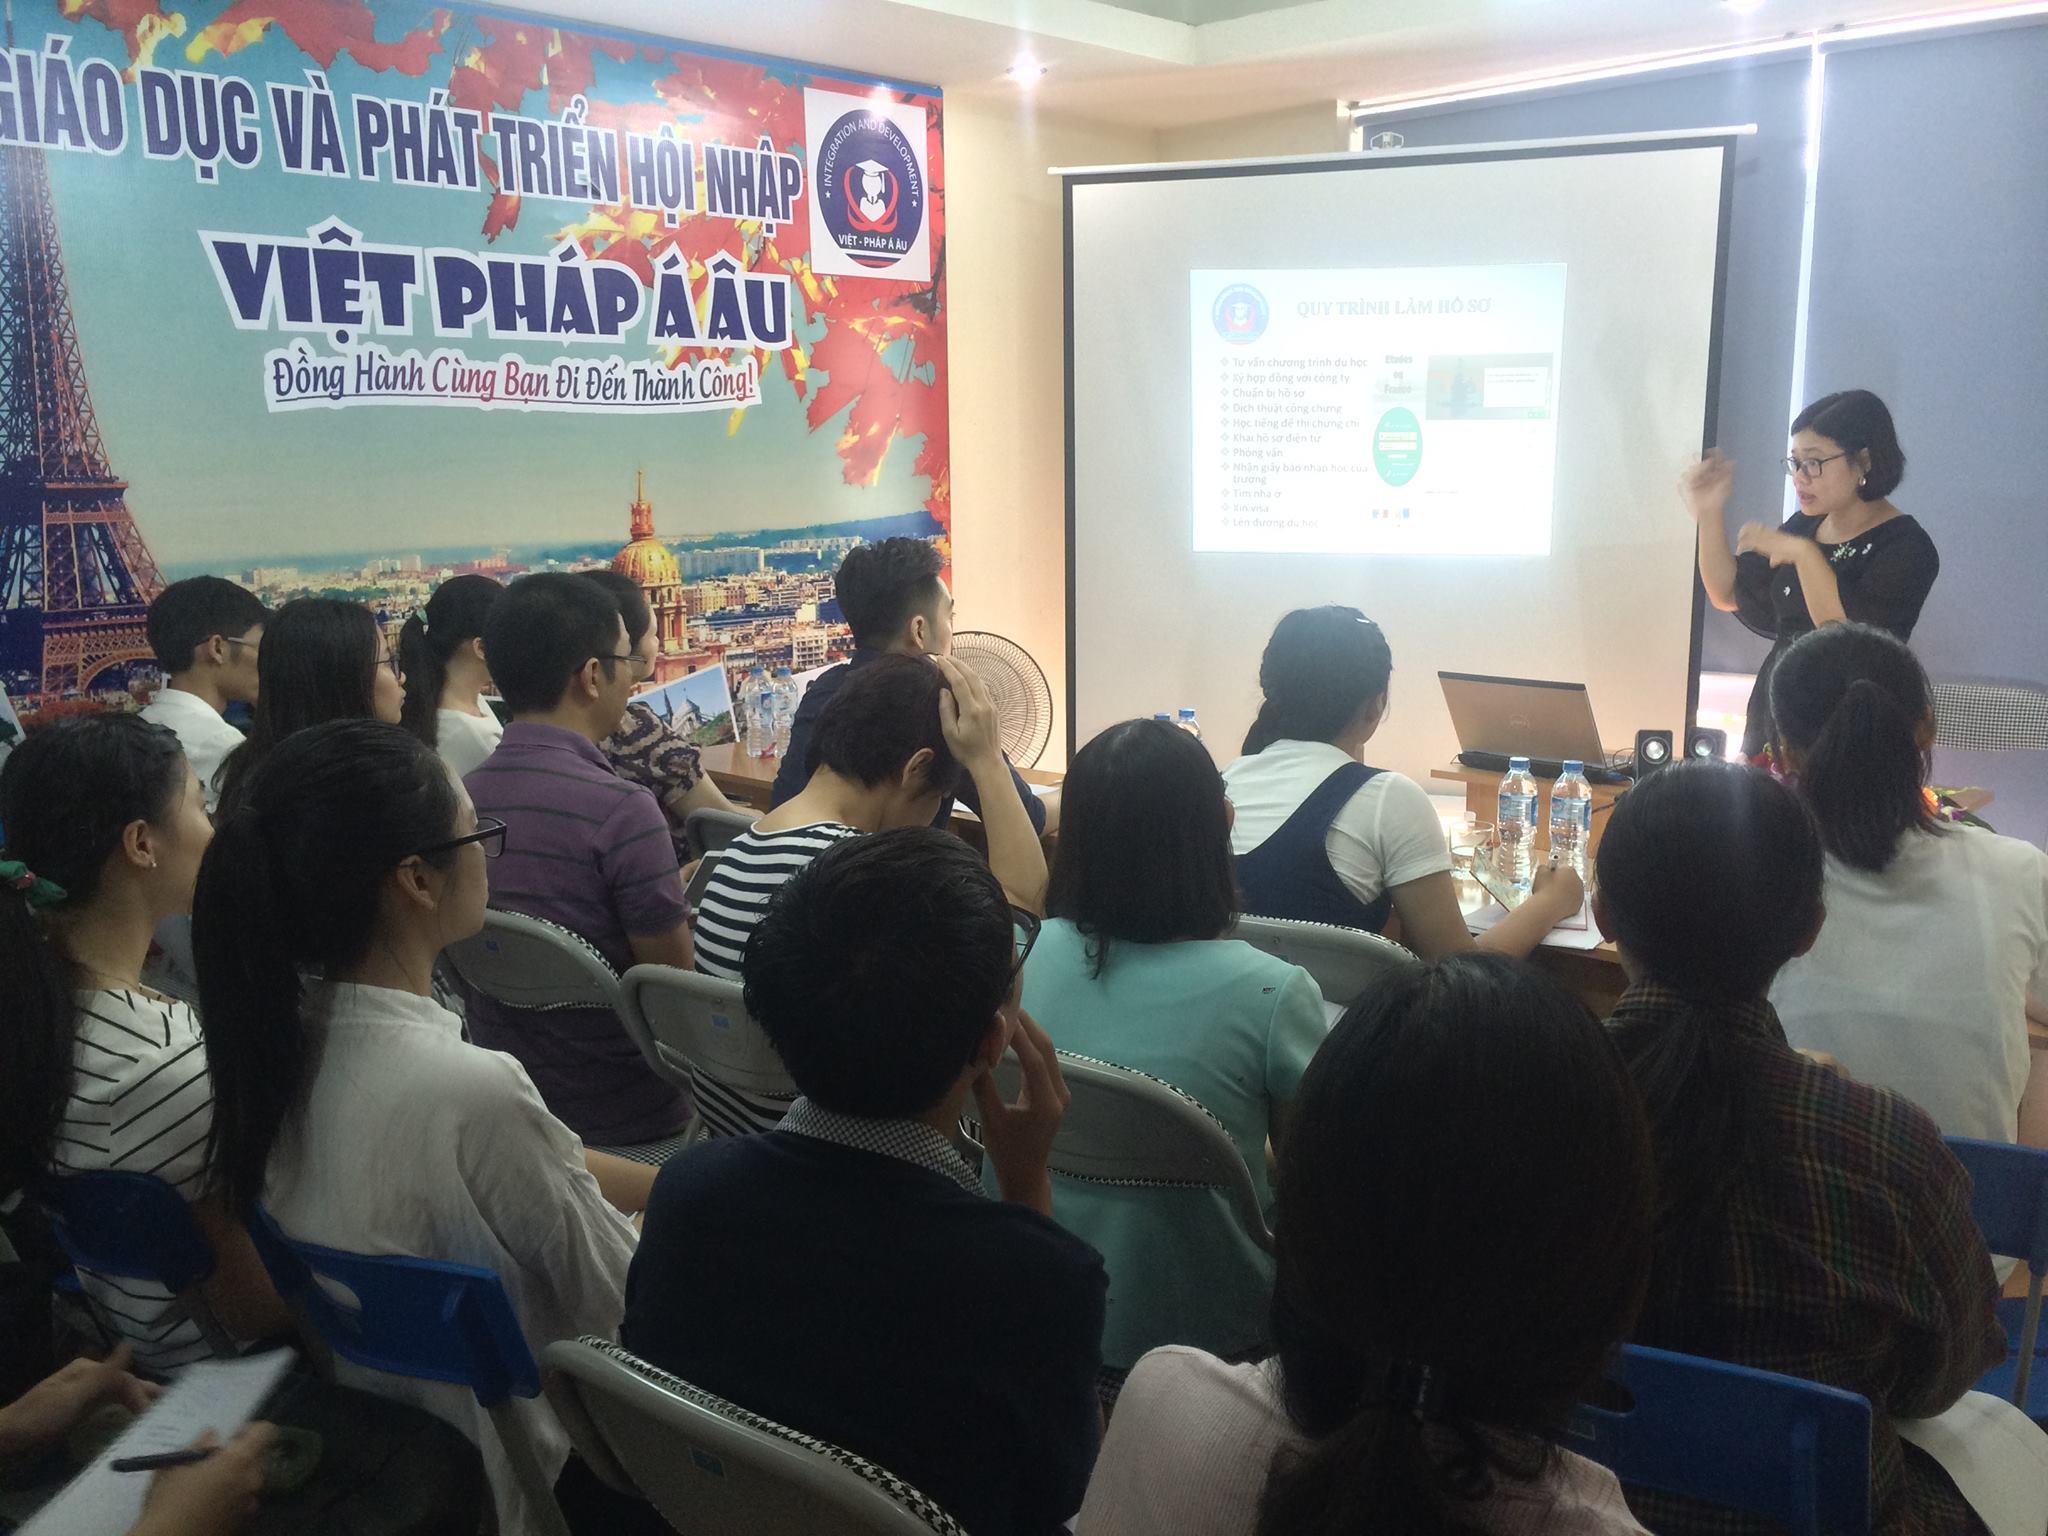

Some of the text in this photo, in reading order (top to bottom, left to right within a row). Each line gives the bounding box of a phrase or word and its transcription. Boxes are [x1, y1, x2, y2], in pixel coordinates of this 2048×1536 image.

[139, 70, 259, 179] DỤC
[270, 75, 346, 174] VÀ
[356, 92, 480, 189] PHÁT
[491, 95, 620, 202] TRIỂN
[629, 126, 696, 224] HỘI
[704, 139, 801, 234] NHẬP
[823, 119, 920, 197] INTEGRATION AND DEVELOPMENT
[838, 233, 858, 248] VIỆT
[863, 235, 887, 249] PHÁP
[888, 237, 895, 250] Á
[896, 237, 908, 251] ÂU
[211, 225, 788, 344] VIỆT PHÁP Á ÂU
[1296, 301, 1333, 318] QUY
[1336, 298, 1390, 316] TRÌNH
[1394, 298, 1433, 315] LÀM
[1467, 297, 1492, 313] SƠ
[273, 346, 755, 404] Đồng Hành Cùng Bạn Đi Đến Thành Công!
